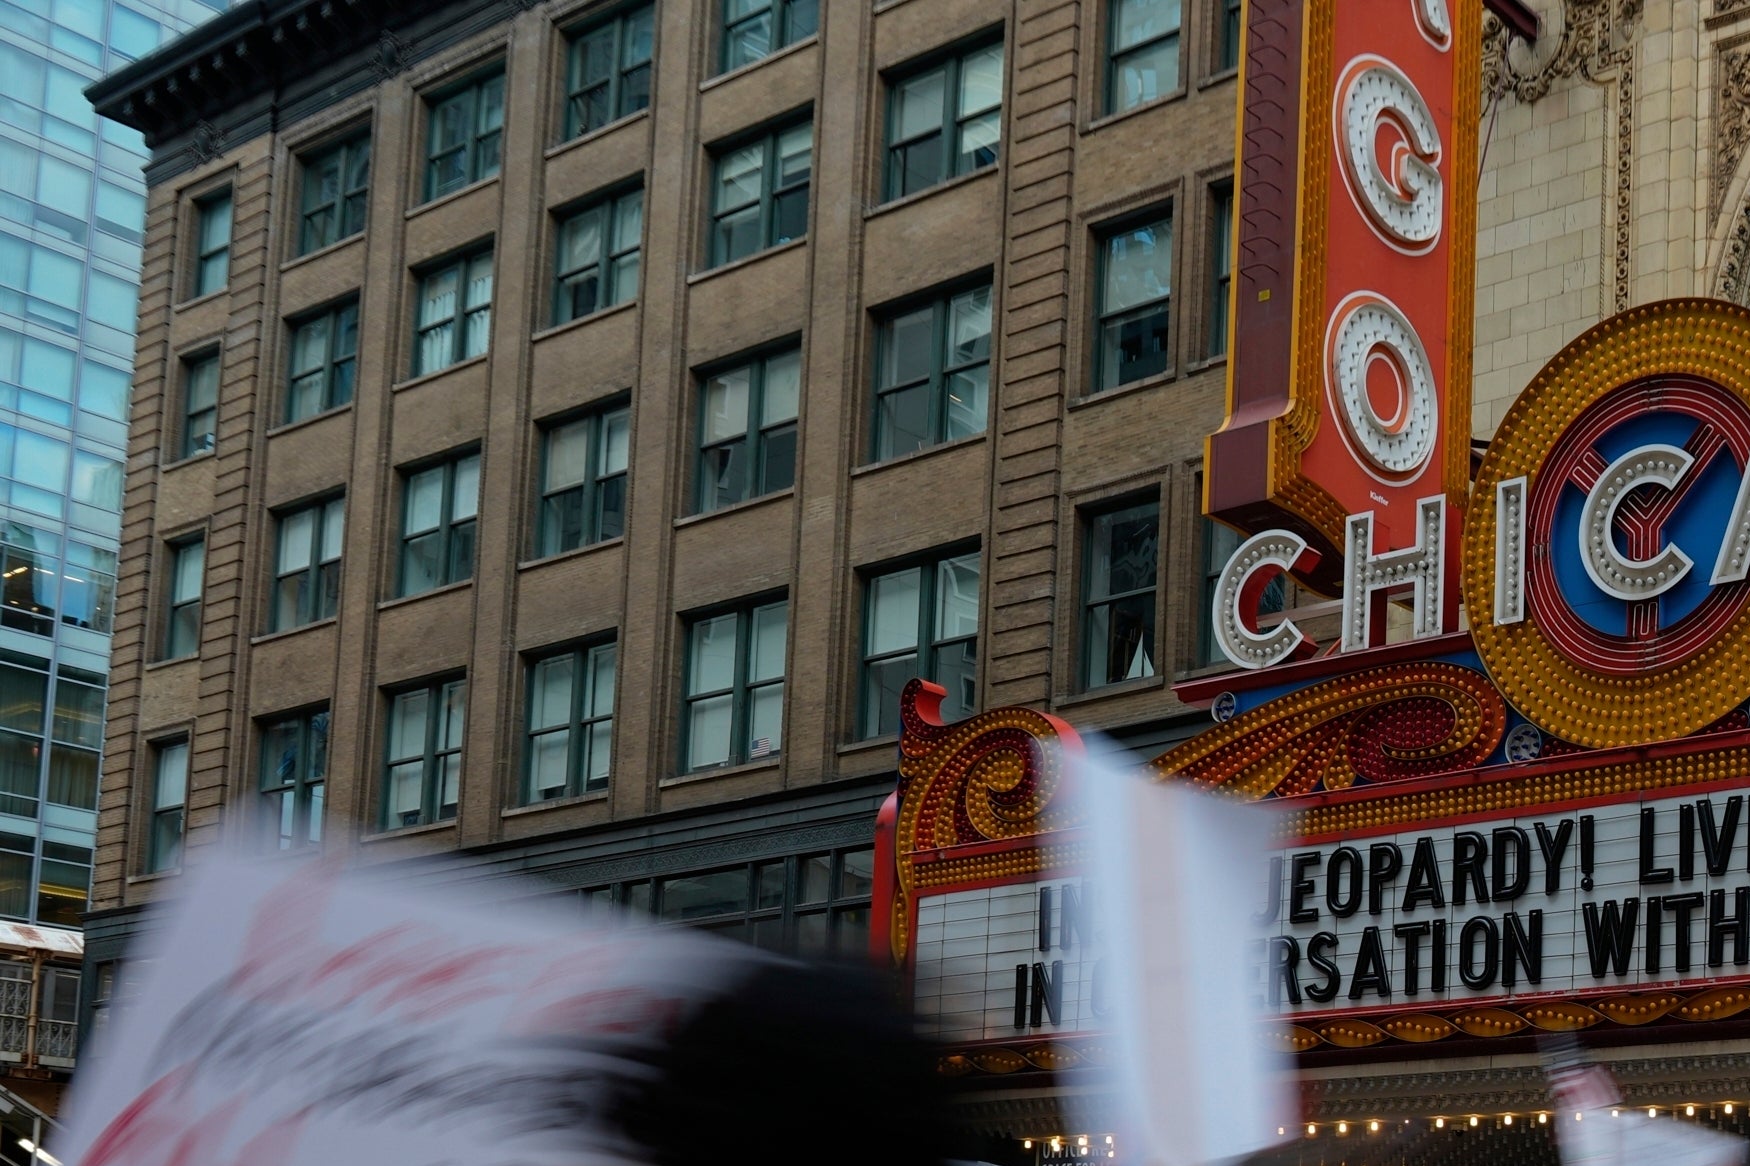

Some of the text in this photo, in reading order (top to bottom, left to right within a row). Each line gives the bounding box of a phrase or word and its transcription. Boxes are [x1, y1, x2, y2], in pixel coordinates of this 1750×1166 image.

[1252, 814, 1595, 926] JEOPARDY!
[1014, 959, 1063, 1029] IN
[1582, 885, 1750, 979] WITH
